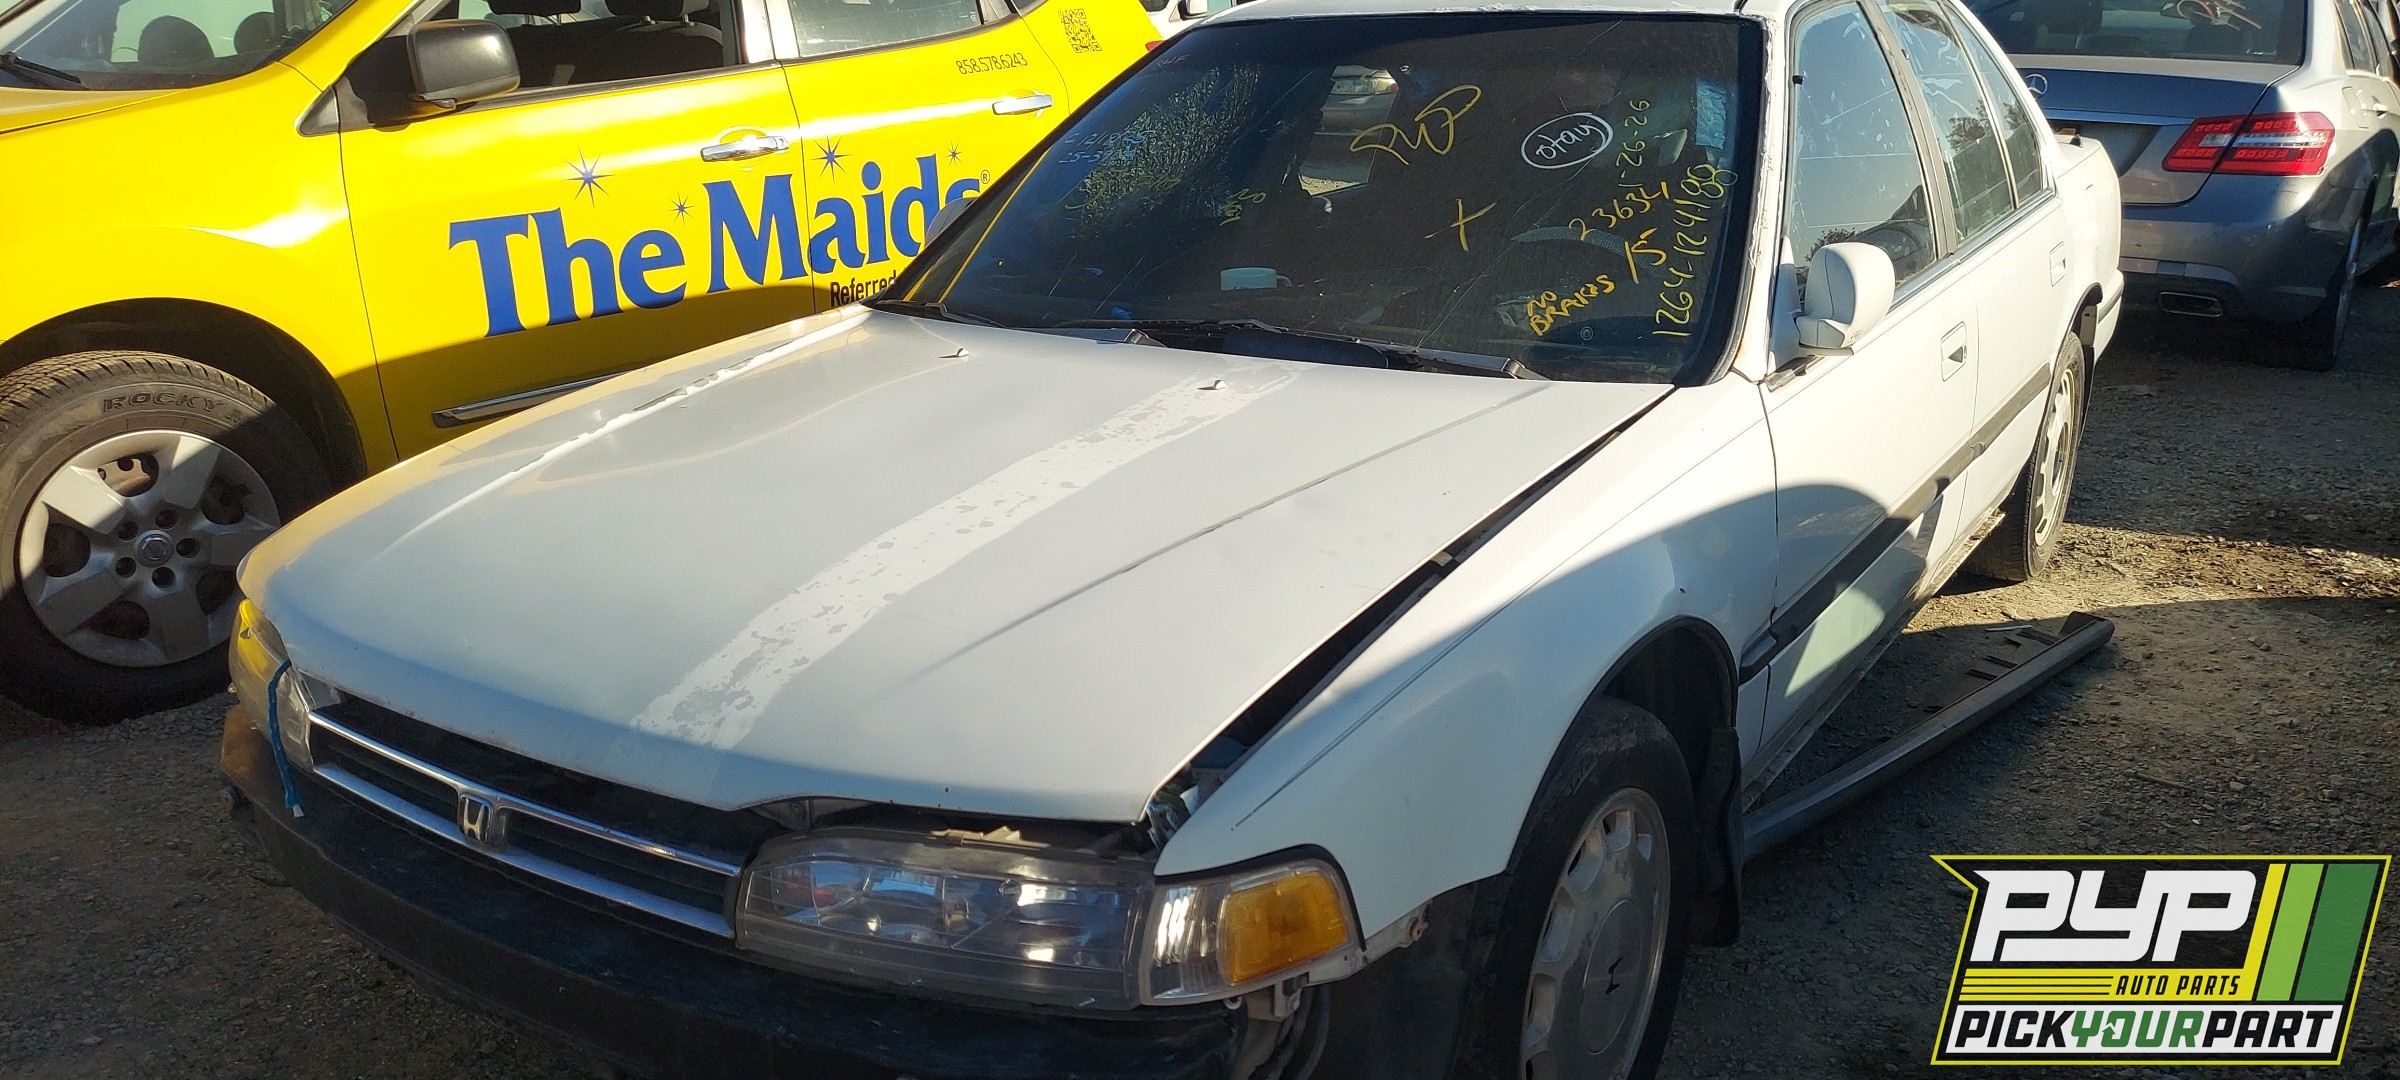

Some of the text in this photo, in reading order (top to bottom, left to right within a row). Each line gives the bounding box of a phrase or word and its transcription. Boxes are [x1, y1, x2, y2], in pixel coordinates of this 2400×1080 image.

[956, 53, 1028, 75] 858.578.6243
[449, 207, 687, 338] The
[103, 391, 225, 413] ROCKY
